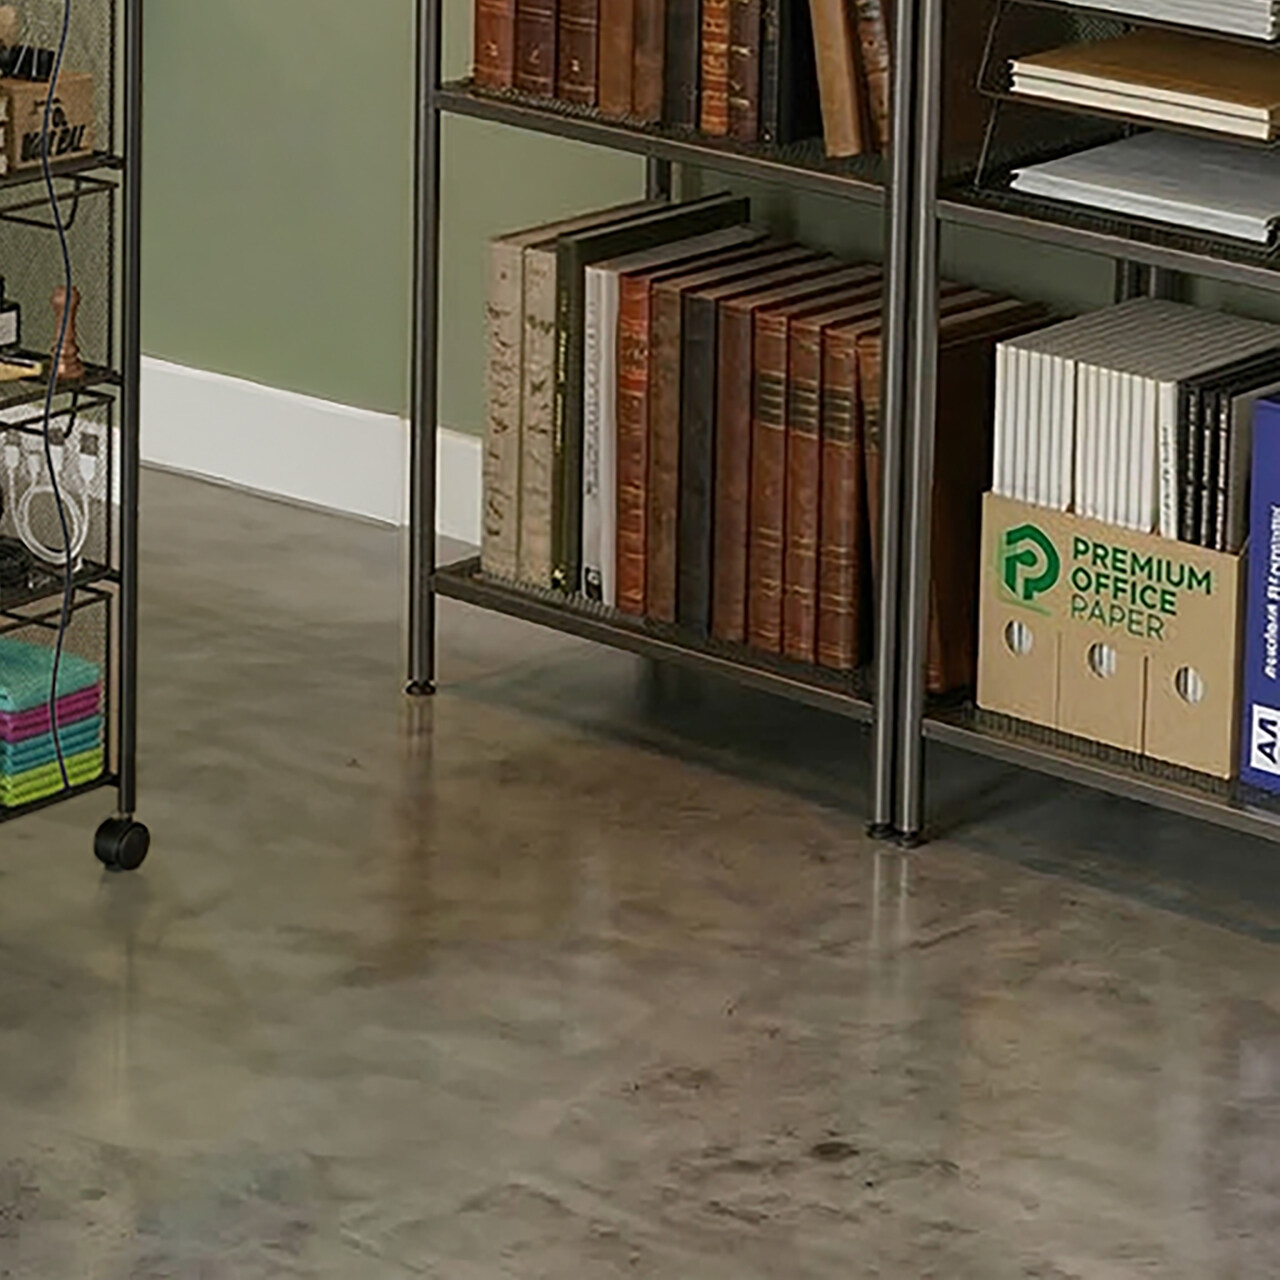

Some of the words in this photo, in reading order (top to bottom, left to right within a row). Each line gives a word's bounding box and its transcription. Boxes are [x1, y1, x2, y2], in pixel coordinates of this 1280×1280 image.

[1072, 536, 1211, 595] PREMIUM
[1071, 567, 1177, 616] OFFICE
[1071, 594, 1164, 641] PAPER
